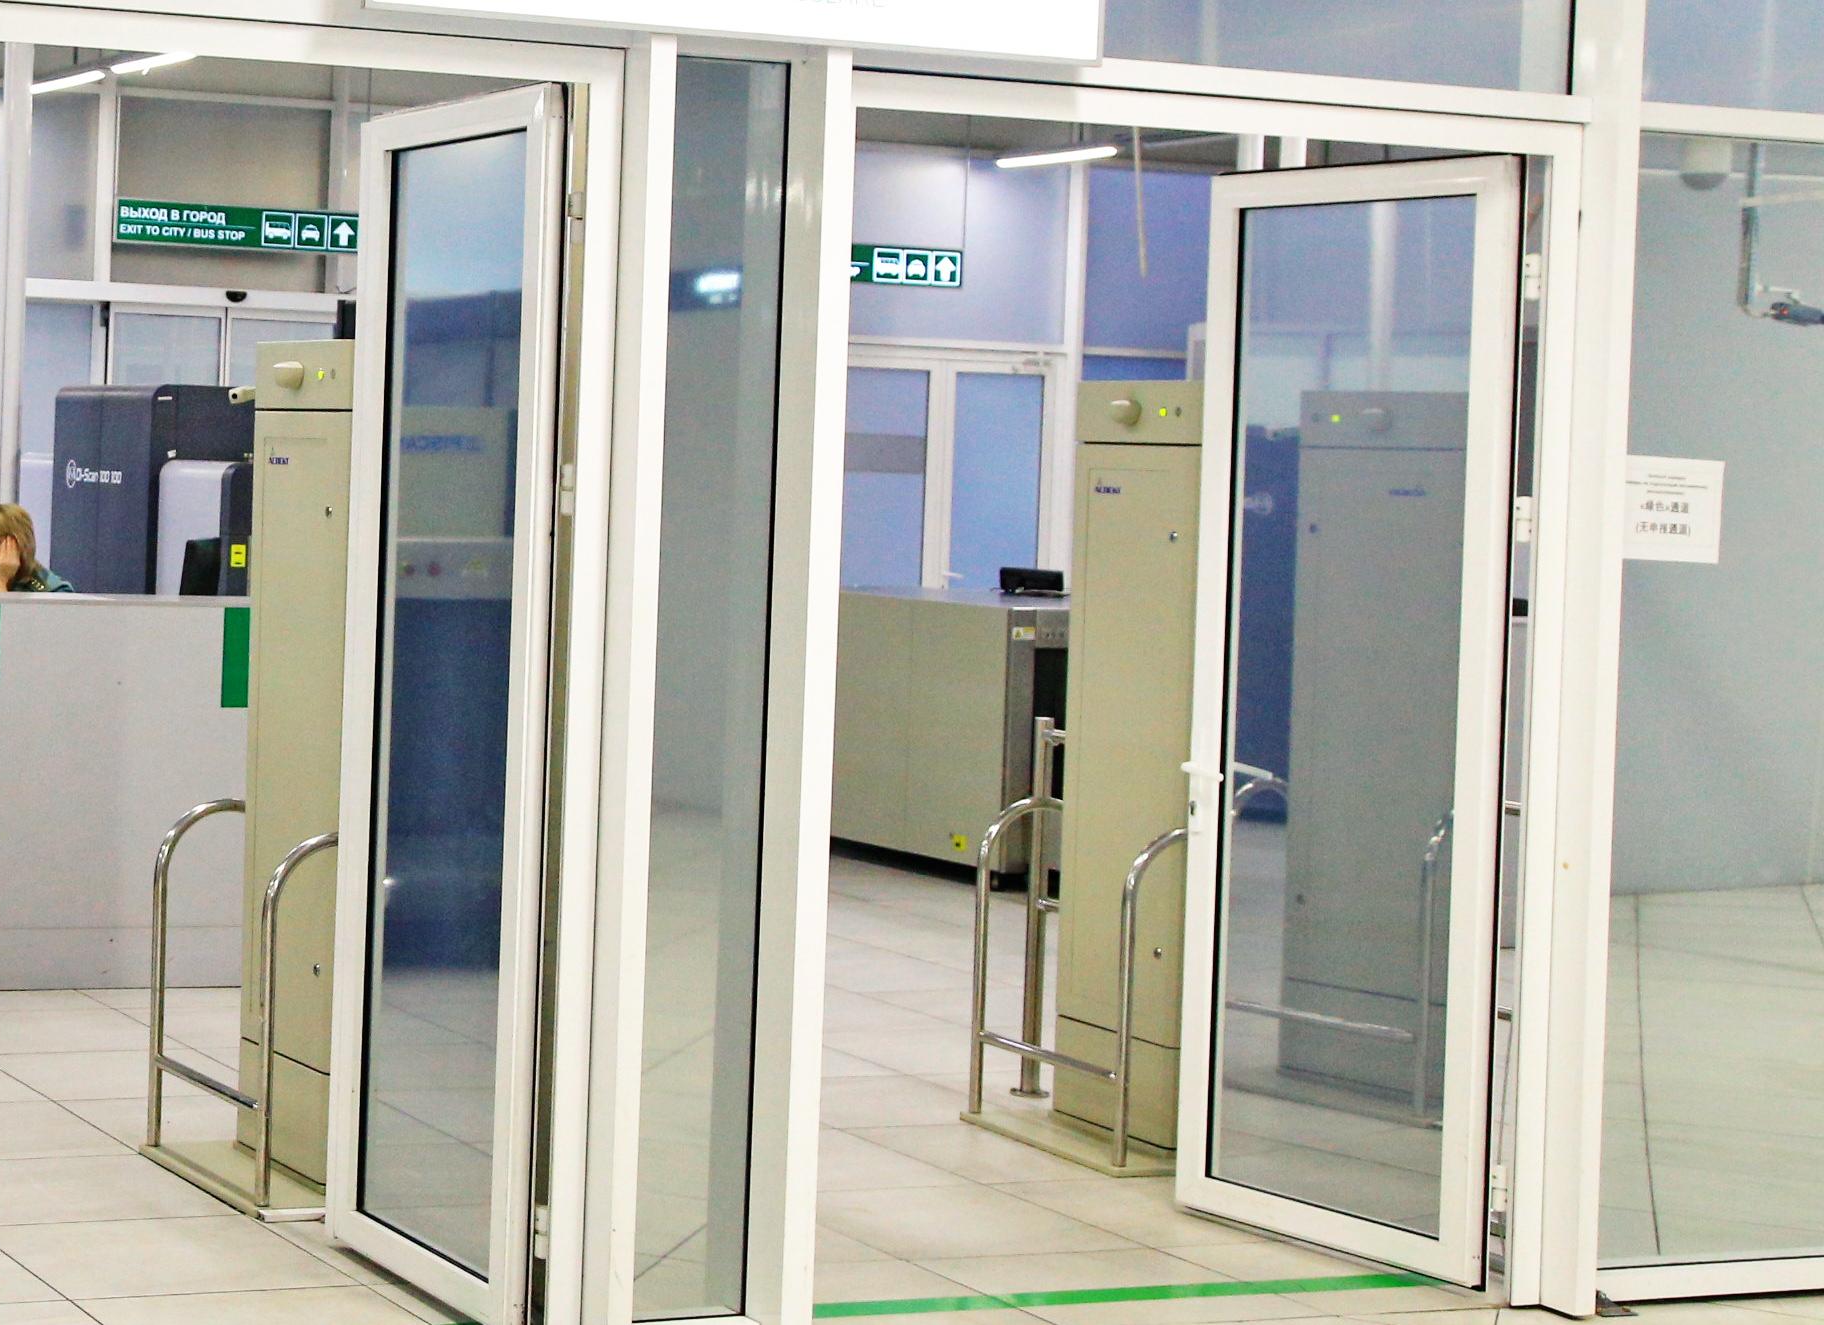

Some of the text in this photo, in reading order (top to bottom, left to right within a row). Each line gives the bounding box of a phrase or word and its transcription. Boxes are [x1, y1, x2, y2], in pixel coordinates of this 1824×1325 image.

[120, 206, 226, 226] ВЫХОД В ГОРОД
[119, 223, 143, 234] EXIT
[145, 225, 160, 235] TO
[162, 226, 186, 237] CITY
[193, 228, 216, 239] BUS
[217, 230, 246, 241] STOP
